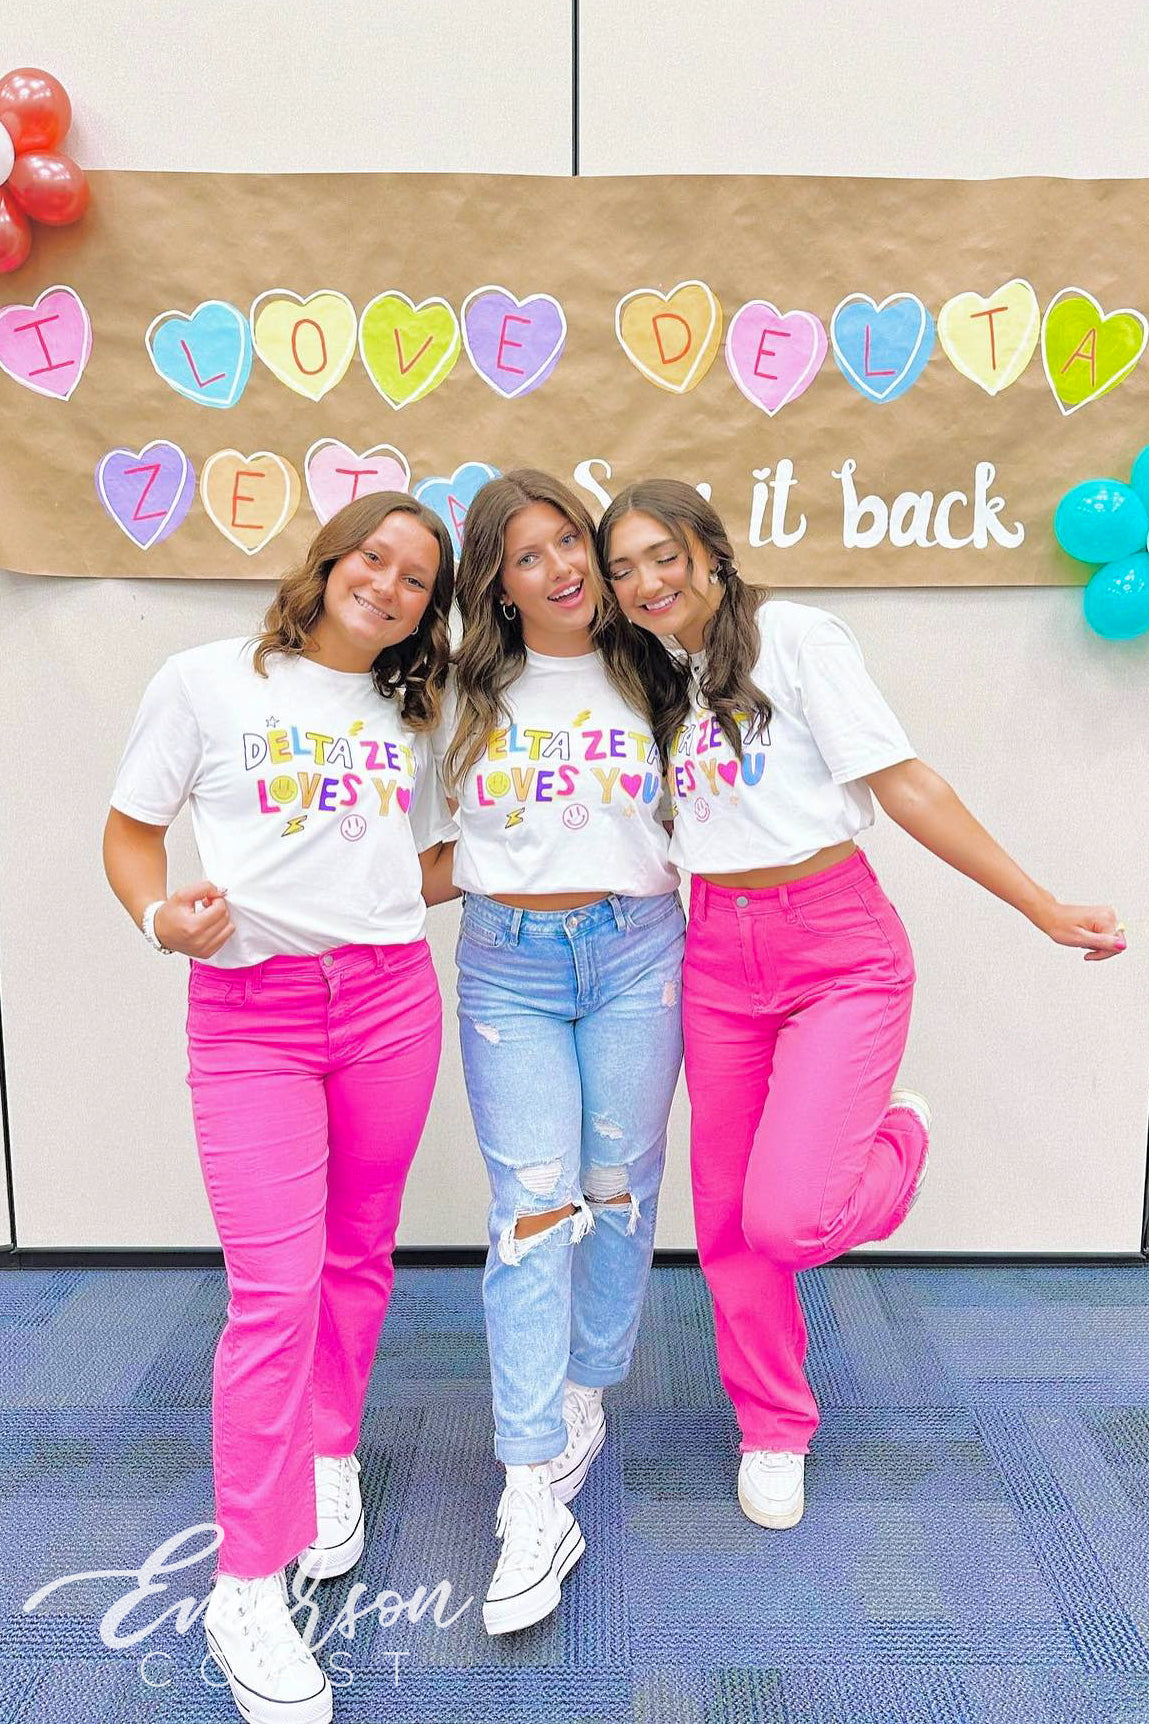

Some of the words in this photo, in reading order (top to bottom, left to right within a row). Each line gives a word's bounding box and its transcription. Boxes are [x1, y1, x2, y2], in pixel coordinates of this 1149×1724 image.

[14, 314, 75, 377] I
[181, 314, 532, 388] LOVE
[652, 305, 1097, 389] DELTA
[749, 458, 808, 549] it
[831, 458, 1025, 549] back
[243, 724, 353, 771] DELTA
[487, 723, 570, 761] ELTA
